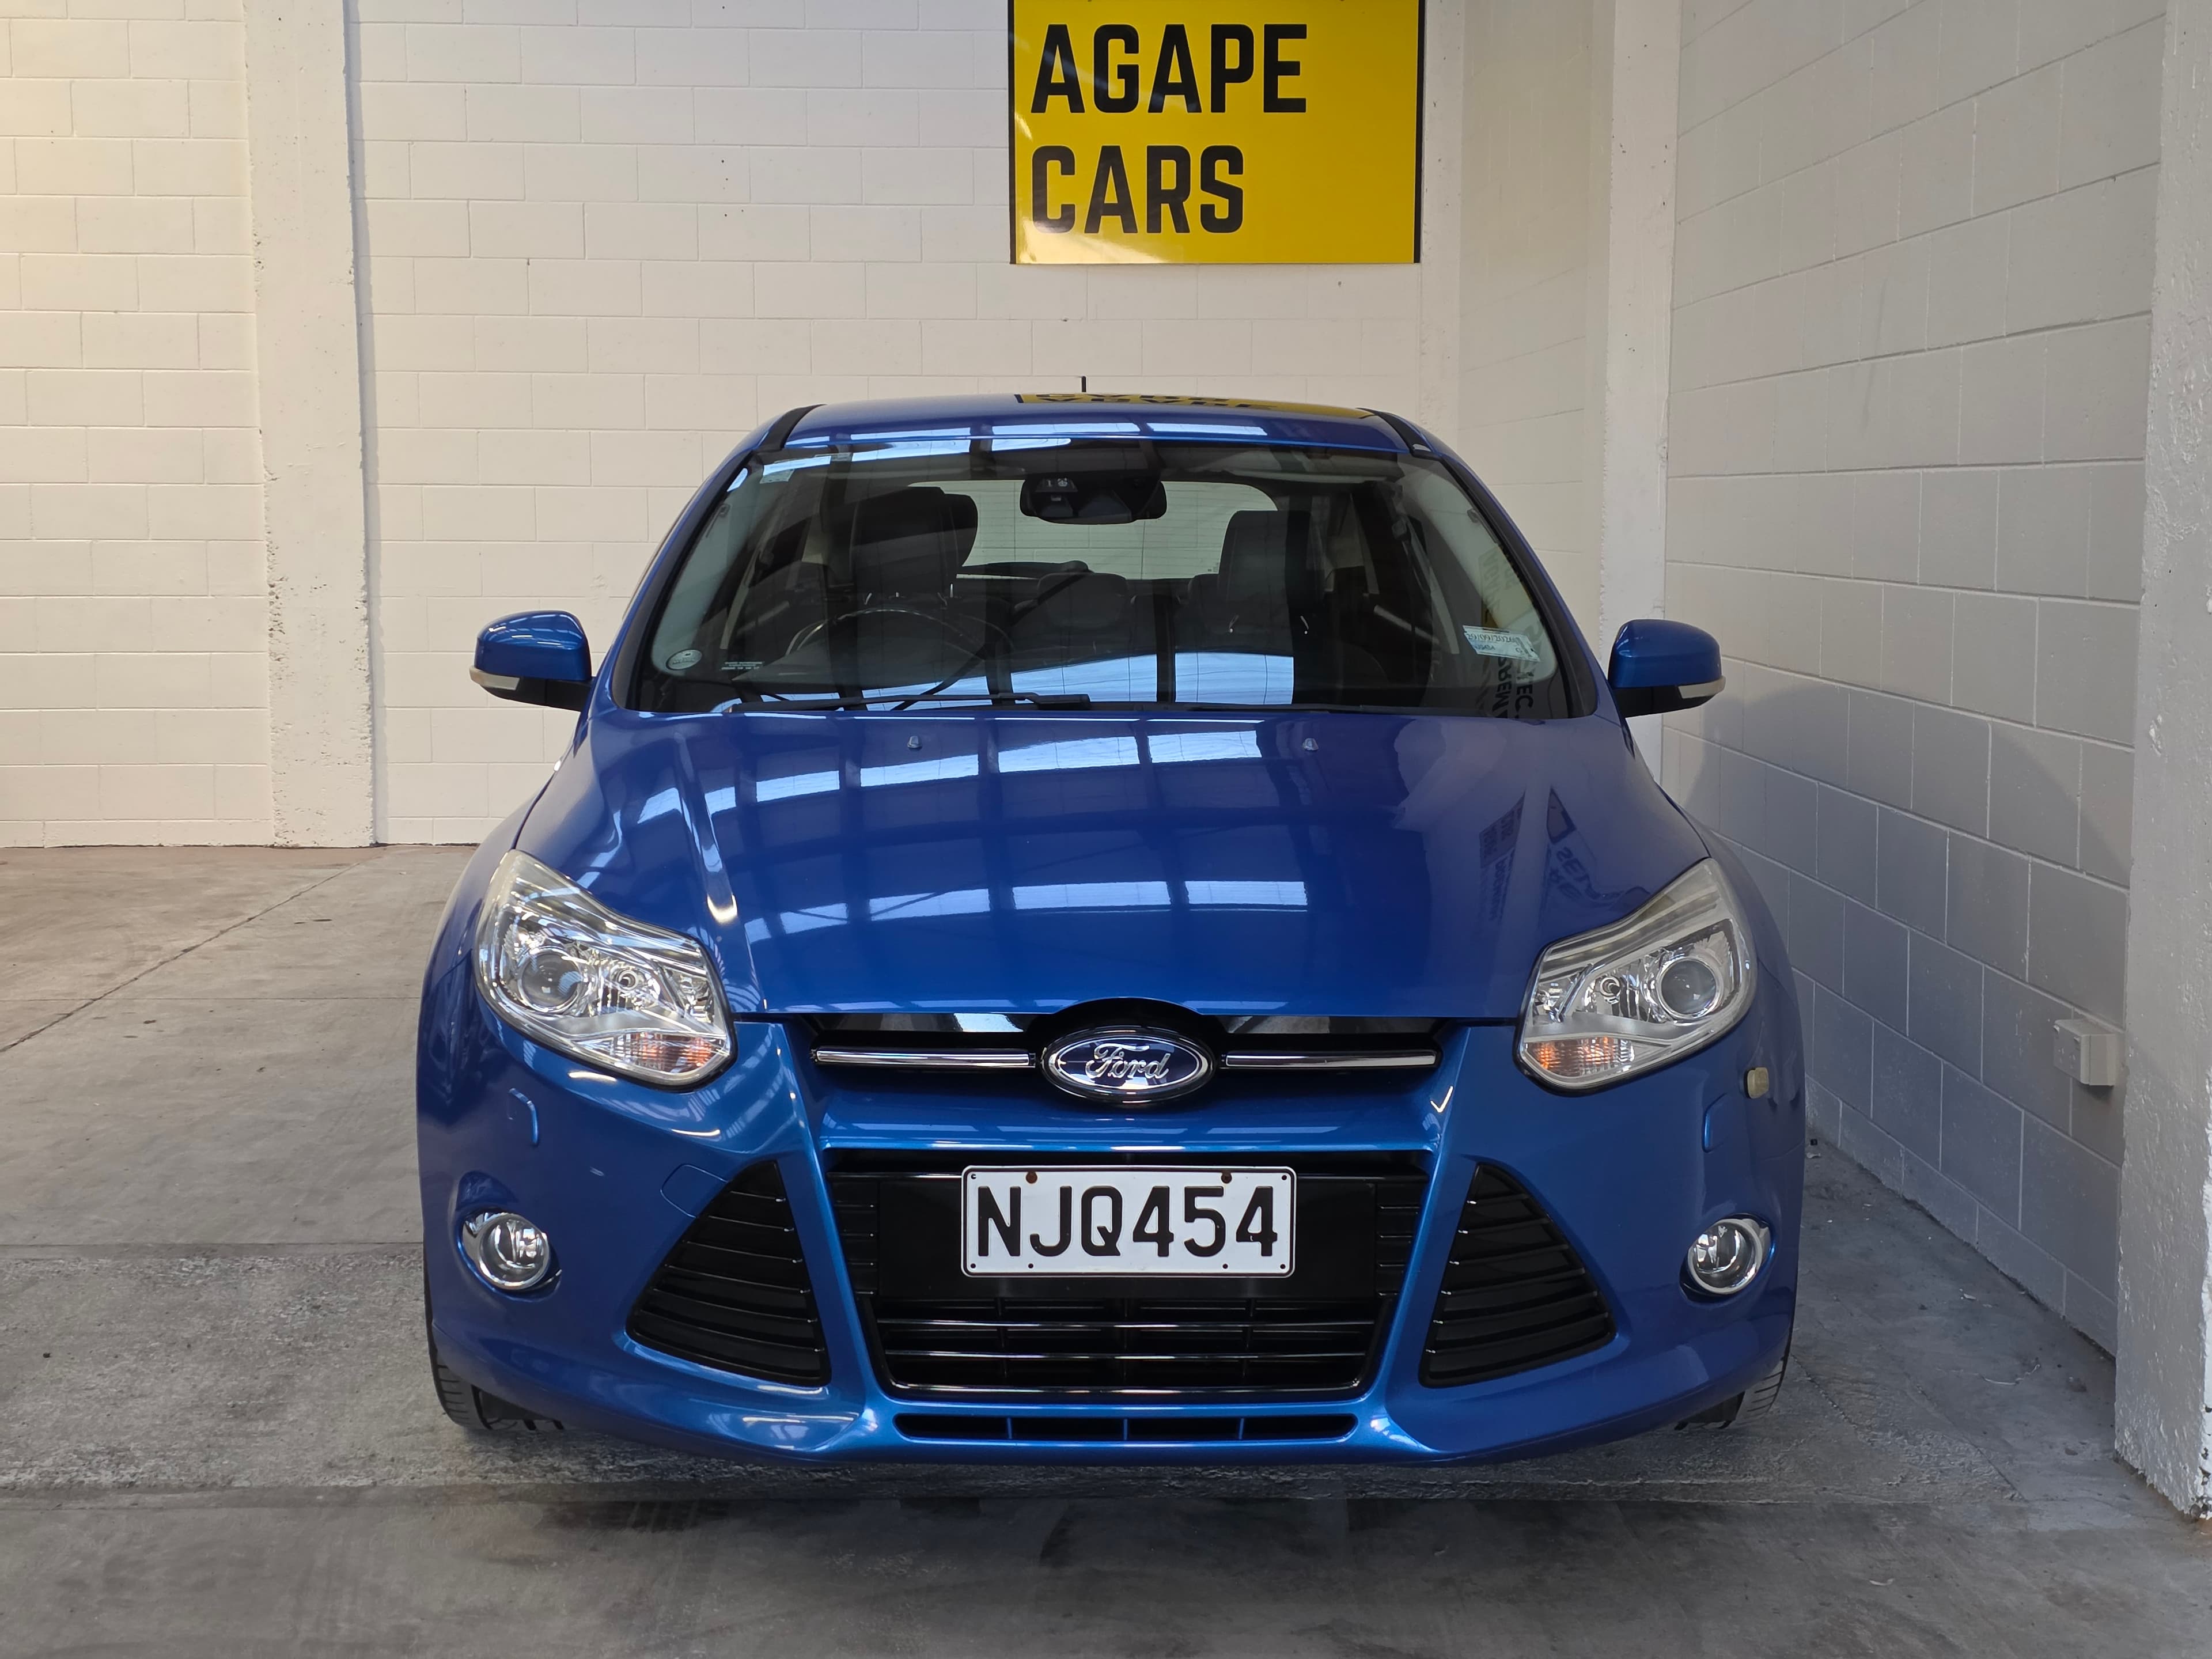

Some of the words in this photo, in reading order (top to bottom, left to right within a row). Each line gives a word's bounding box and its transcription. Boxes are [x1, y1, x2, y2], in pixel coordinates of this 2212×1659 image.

[1031, 24, 1308, 113] AGAPE
[1032, 145, 1244, 234] CARS
[1085, 1043, 1171, 1079] Ford
[978, 1185, 1278, 1257] NJQ454
